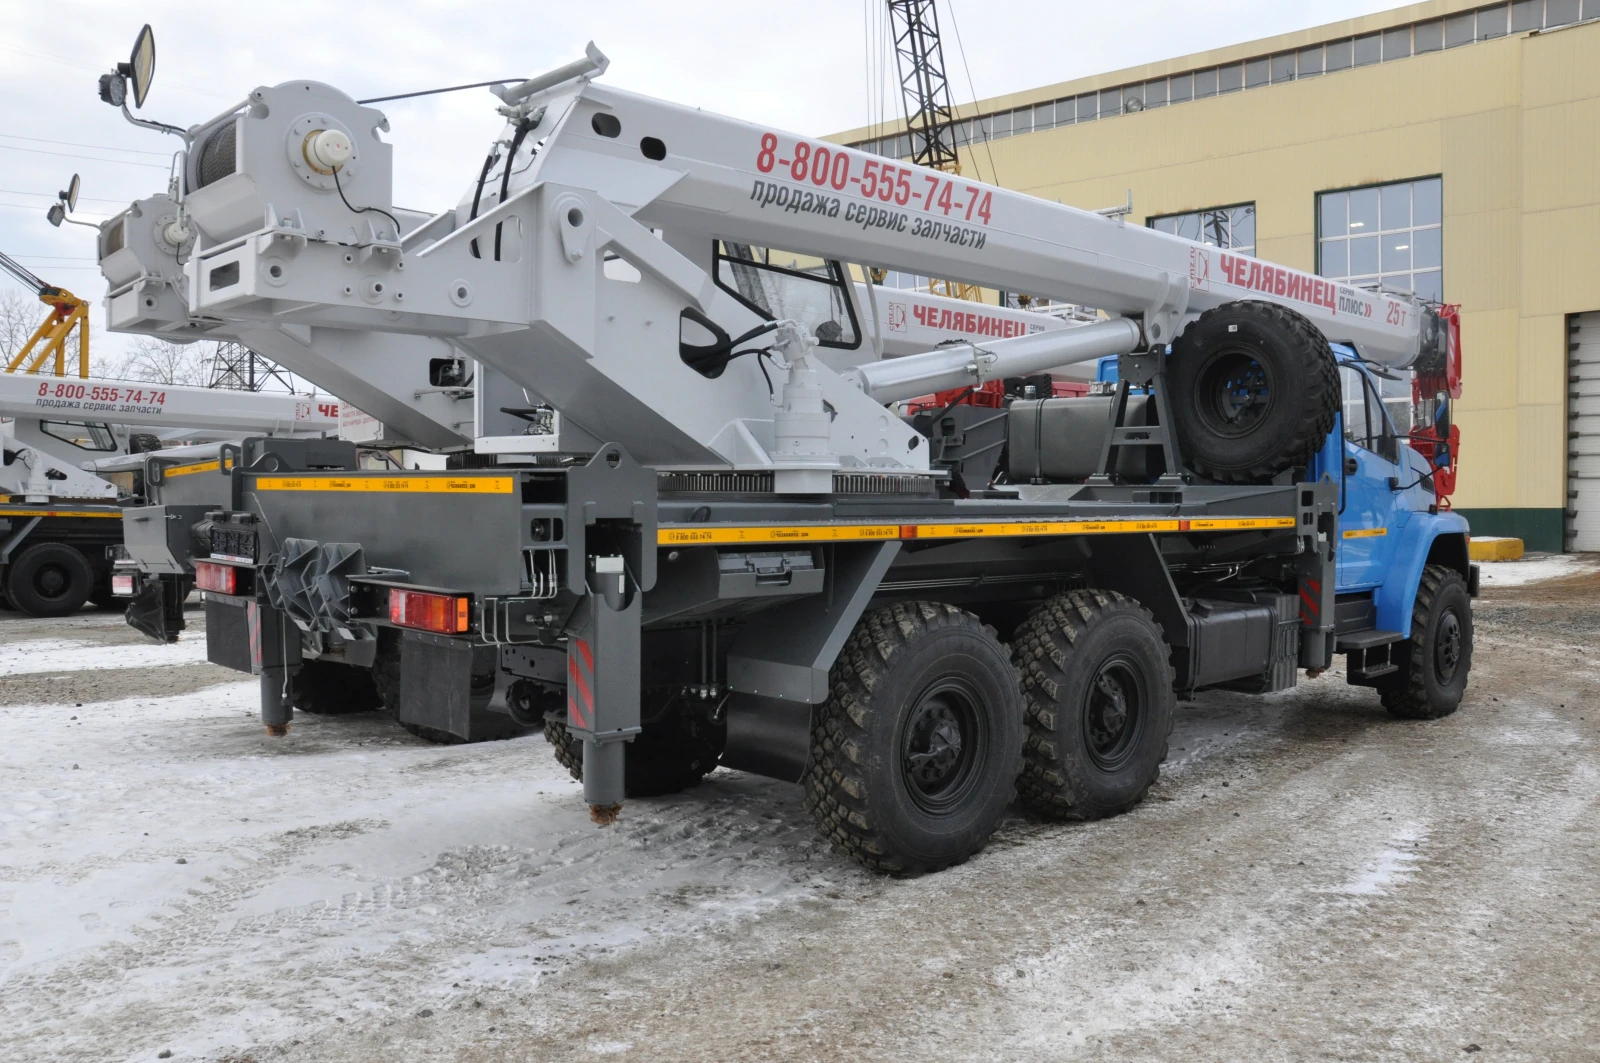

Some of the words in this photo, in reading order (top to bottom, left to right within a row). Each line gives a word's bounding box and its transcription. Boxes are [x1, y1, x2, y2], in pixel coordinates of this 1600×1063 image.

[756, 132, 993, 225] 8-800-555-74-74
[750, 180, 840, 218] продажа
[845, 201, 908, 232] сервис
[911, 217, 987, 250] запчасти
[1220, 254, 1337, 316] ЧЕЛЯБИНЕЦ
[913, 304, 1026, 339] ЧЕЛЯБИНЕЦ
[1386, 300, 1401, 326] 25
[36, 399, 81, 409] продажа
[83, 402, 116, 412] сервис
[119, 405, 162, 415] запчасти
[38, 382, 166, 406] 8-800-555-74-74
